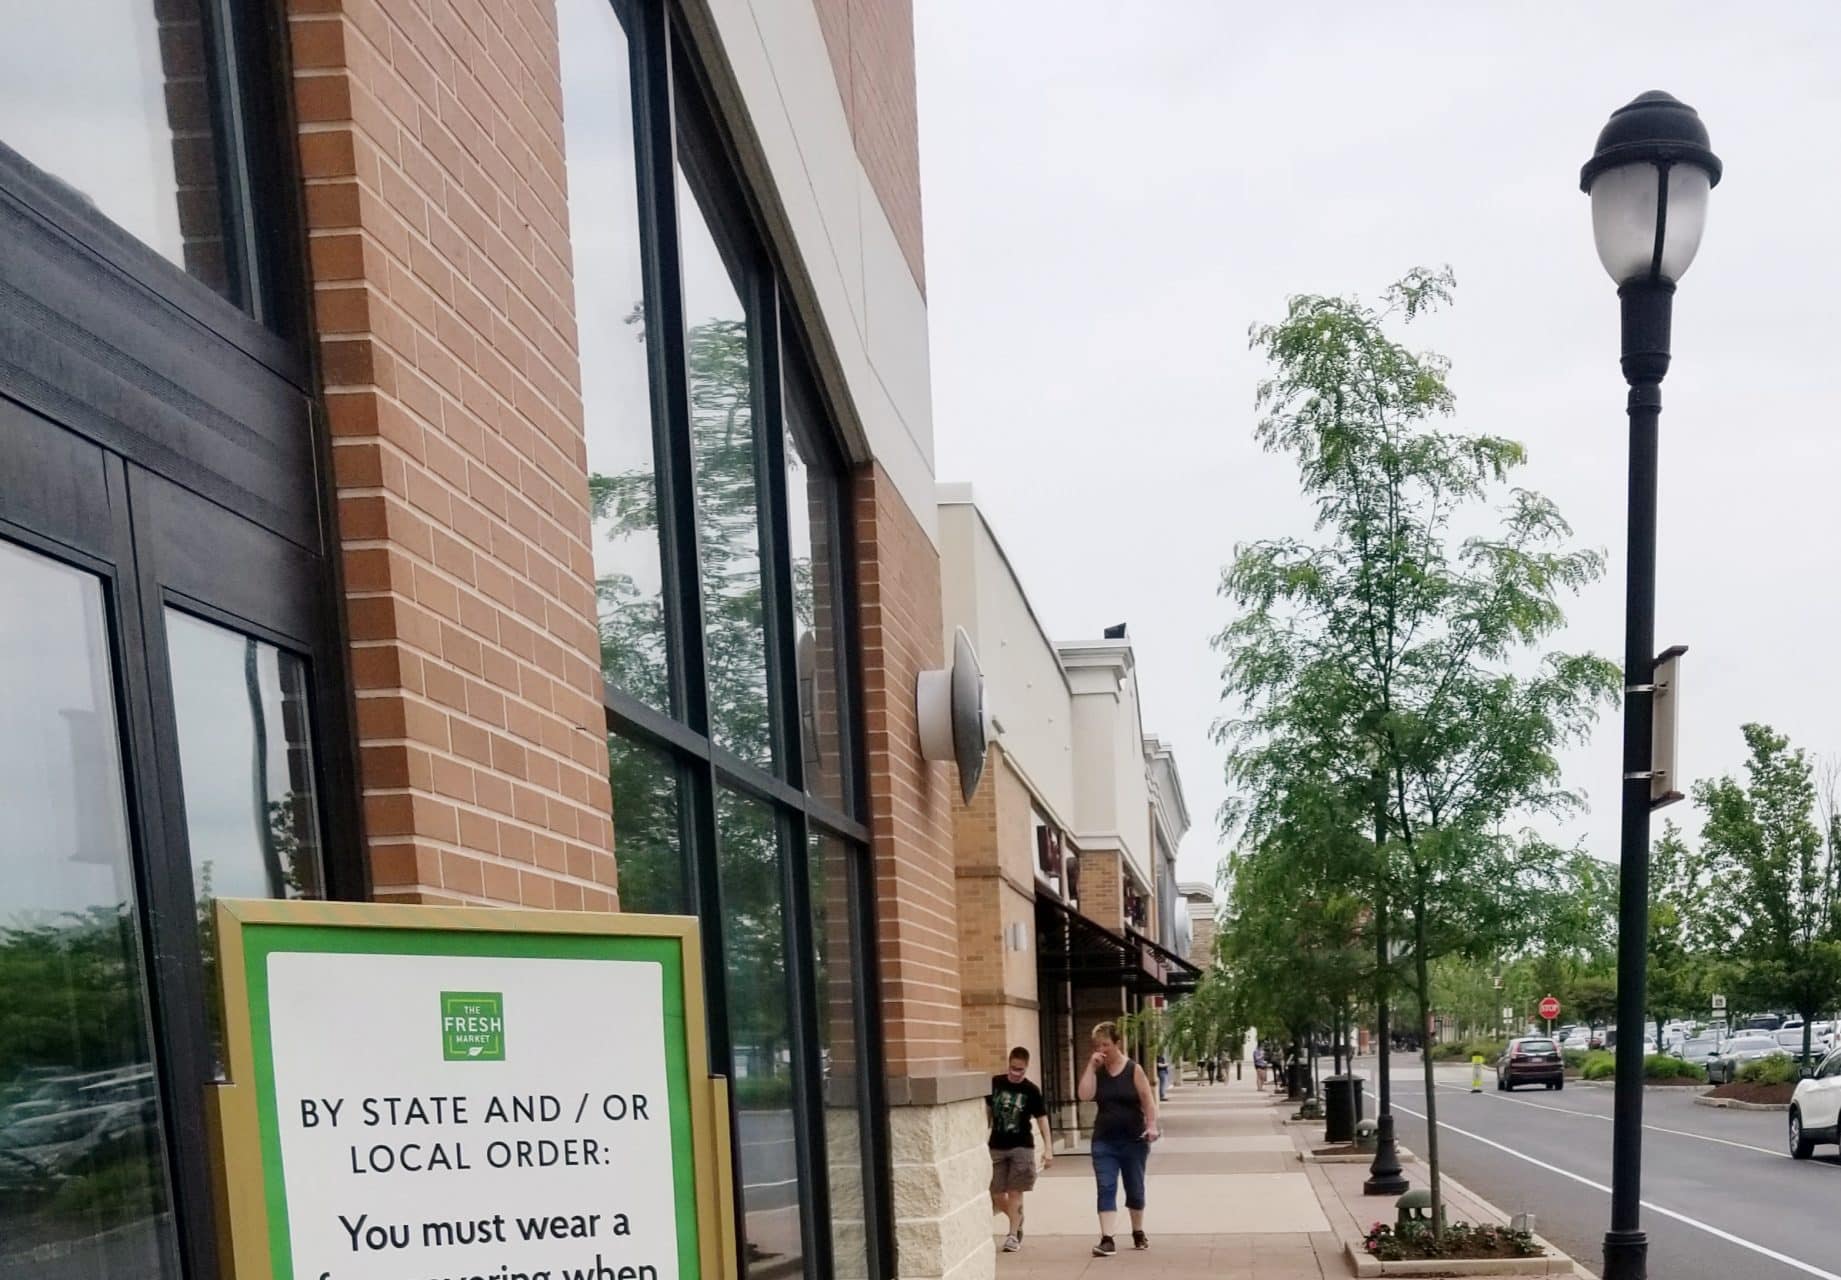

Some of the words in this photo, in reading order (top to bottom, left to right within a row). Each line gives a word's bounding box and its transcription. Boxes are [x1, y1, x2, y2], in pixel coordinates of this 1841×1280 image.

[464, 1005, 481, 1015] THE
[444, 1016, 501, 1032] FRESH
[456, 1034, 490, 1043] MARKET
[300, 1098, 344, 1128] BY
[362, 1096, 468, 1127] STATE
[484, 1095, 561, 1125] AND
[575, 1093, 589, 1124] /
[603, 1094, 649, 1121] OR
[351, 1142, 471, 1174] LOCAL
[486, 1139, 611, 1169] ORDER:
[338, 1214, 410, 1252] You
[422, 1214, 506, 1247] must
[515, 1214, 601, 1242] wear
[613, 1213, 631, 1236] a
